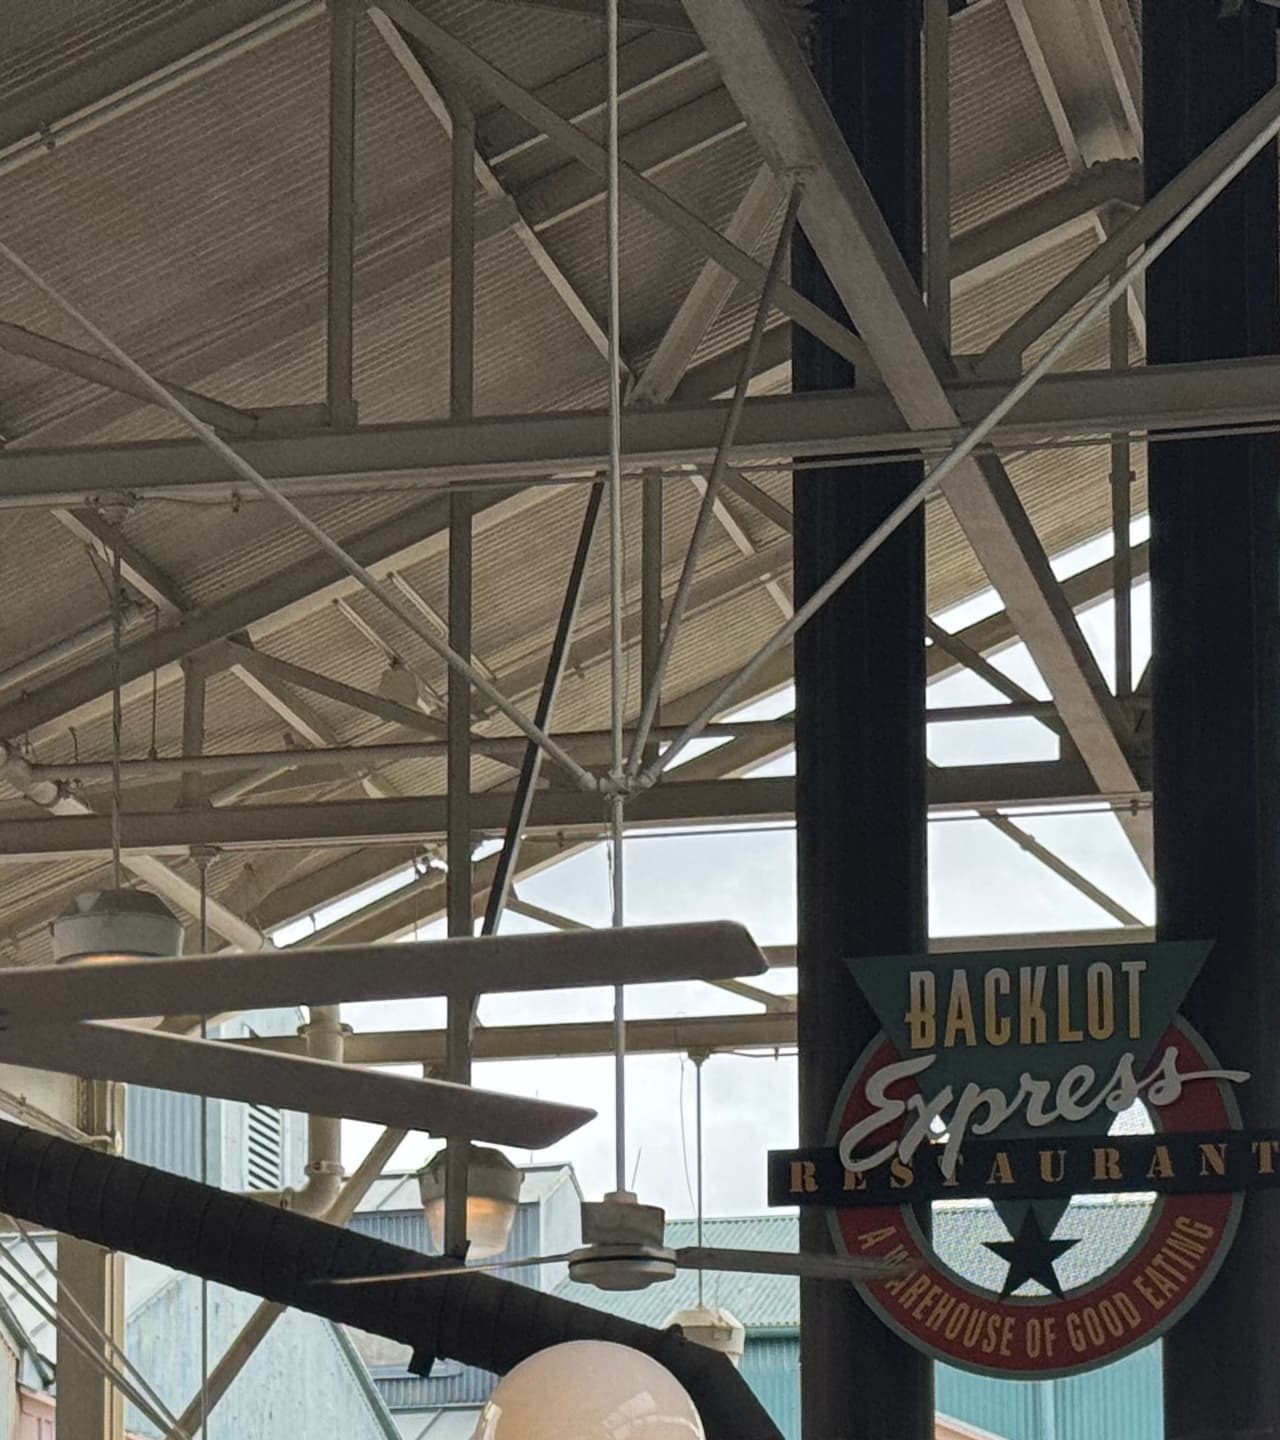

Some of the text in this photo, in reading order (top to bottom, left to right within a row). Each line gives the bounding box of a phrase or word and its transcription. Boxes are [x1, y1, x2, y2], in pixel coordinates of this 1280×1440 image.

[905, 961, 1147, 1050] BACKLOT
[789, 1141, 1280, 1193] RESTAURANT
[838, 1046, 1251, 1180] Express
[857, 1225, 897, 1250] A
[1025, 1317, 1056, 1358] OF
[1066, 1292, 1142, 1352] GOOD
[1133, 1215, 1215, 1310] EATING
